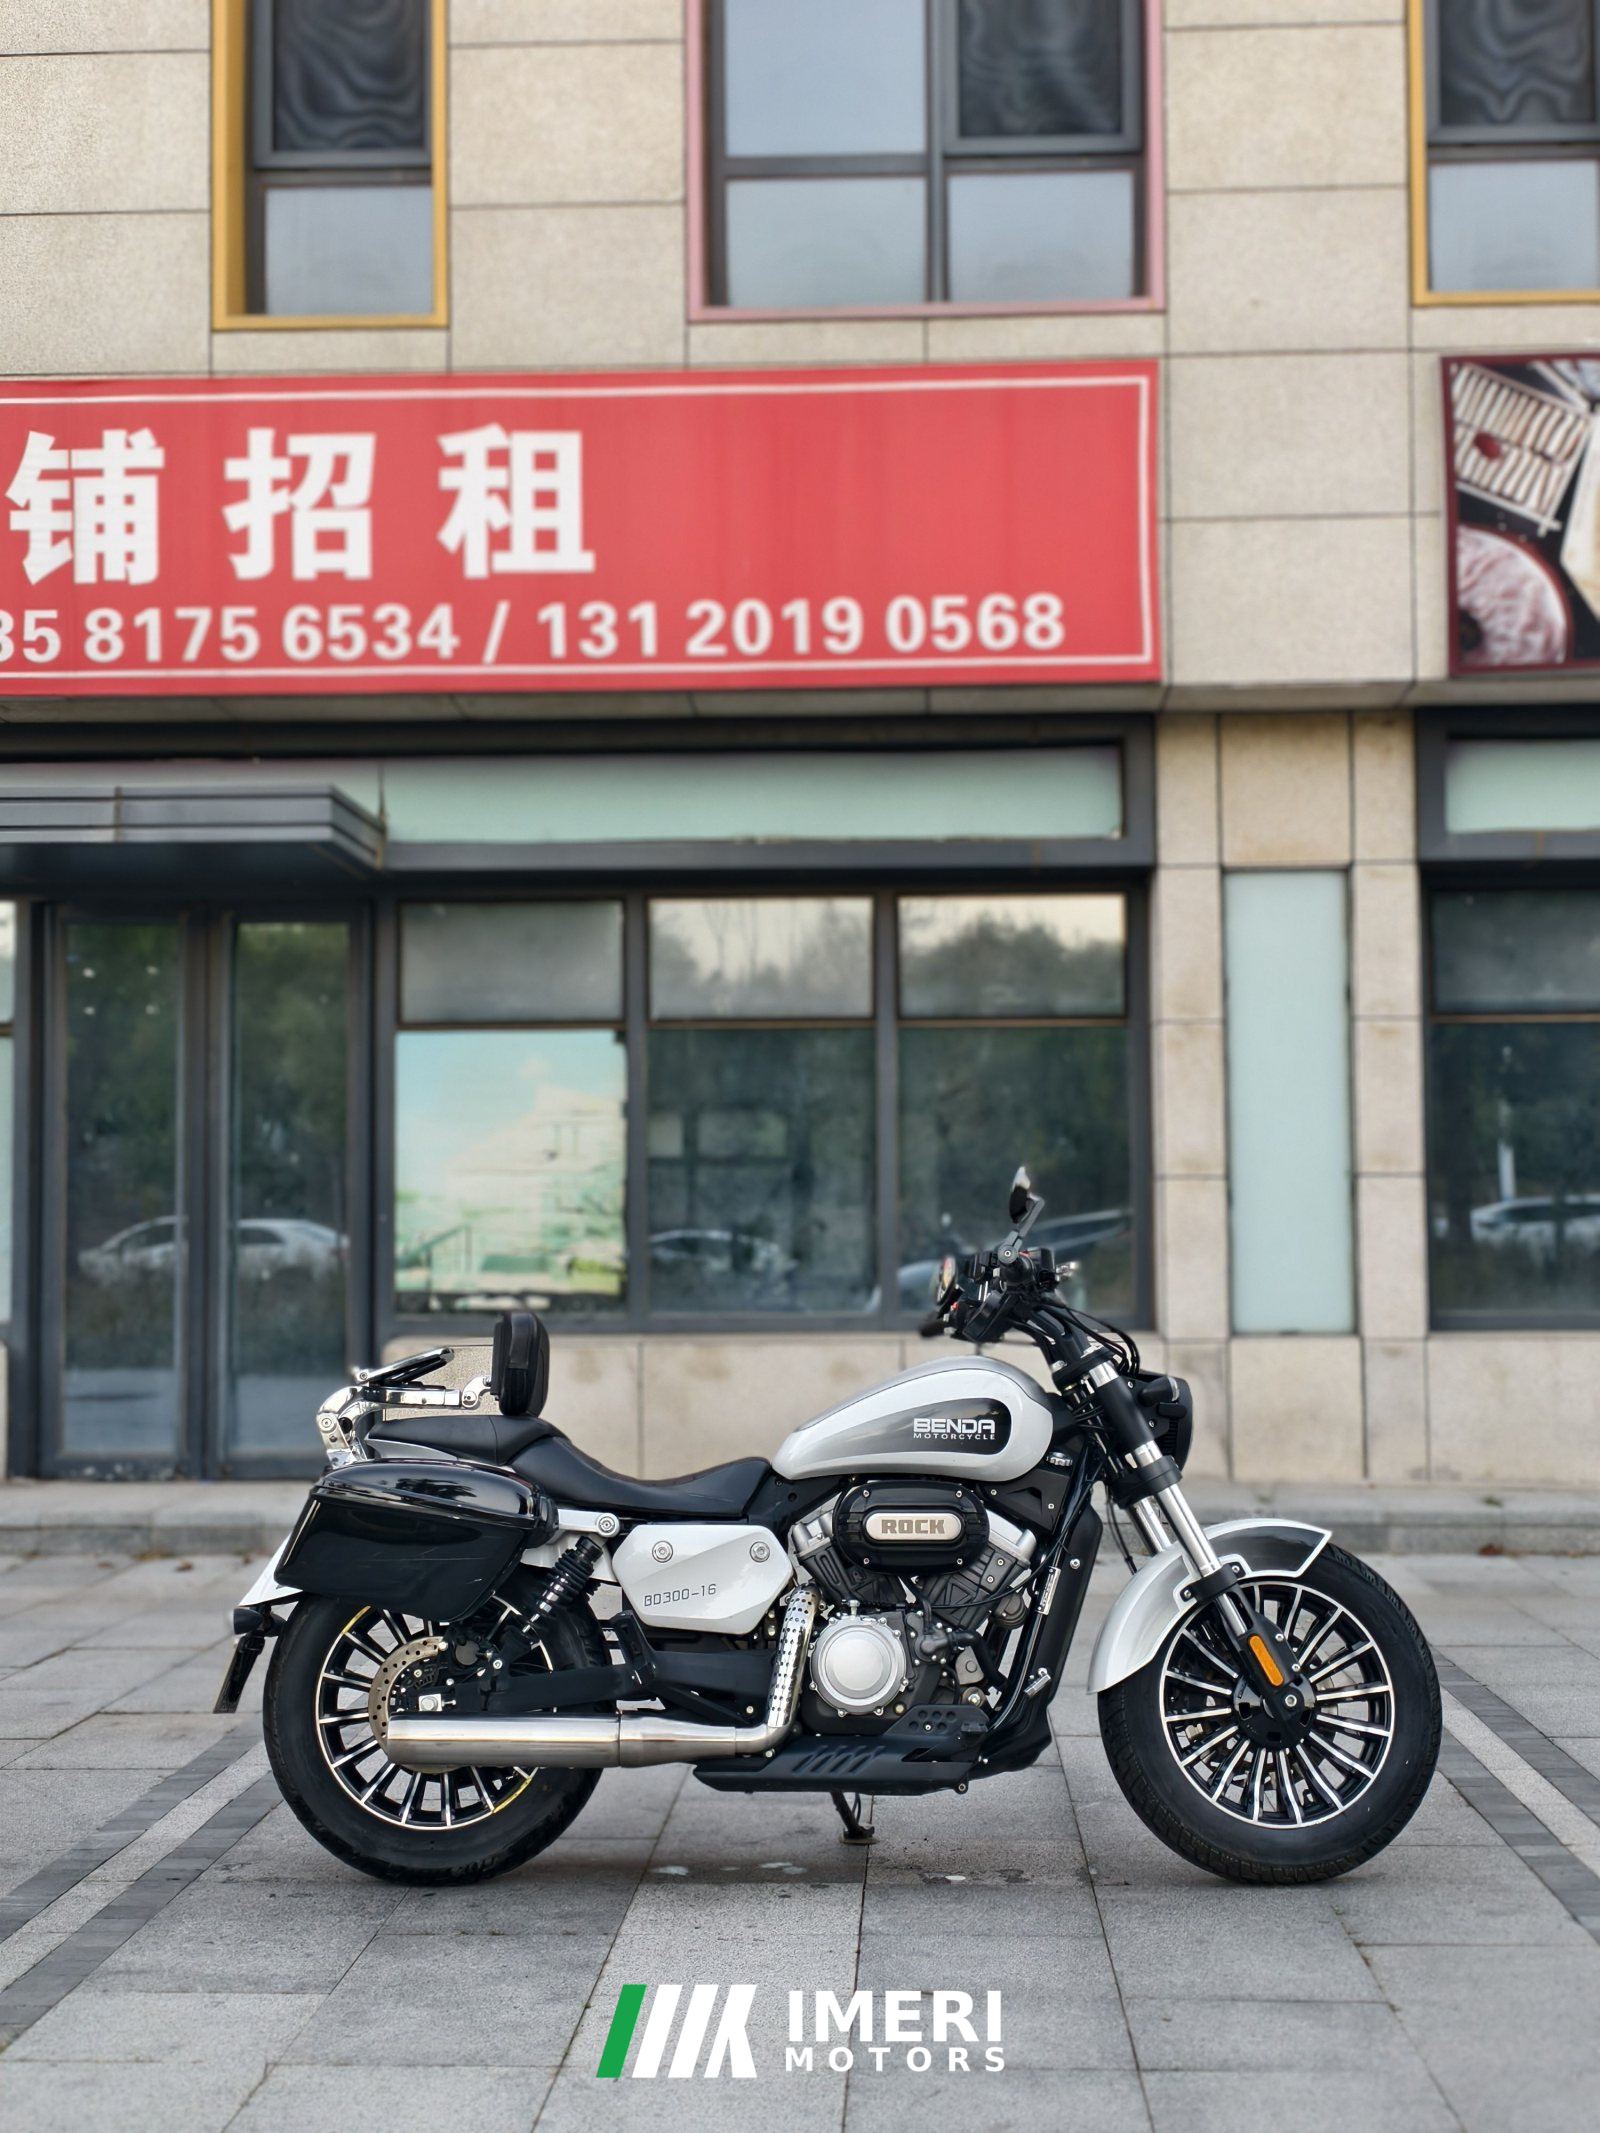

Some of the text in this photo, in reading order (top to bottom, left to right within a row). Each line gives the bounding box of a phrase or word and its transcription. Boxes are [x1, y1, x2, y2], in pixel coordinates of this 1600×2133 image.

[6, 424, 597, 587] 铺招租
[85, 607, 261, 664] 8175
[283, 604, 461, 662] 6534
[484, 601, 511, 667] /
[538, 602, 658, 659] 131
[687, 598, 864, 657] 2019
[886, 594, 1066, 653] 0568
[913, 1418, 996, 1434] BENDA
[881, 1519, 945, 1535] ROCK
[643, 1583, 718, 1607] BD300-16
